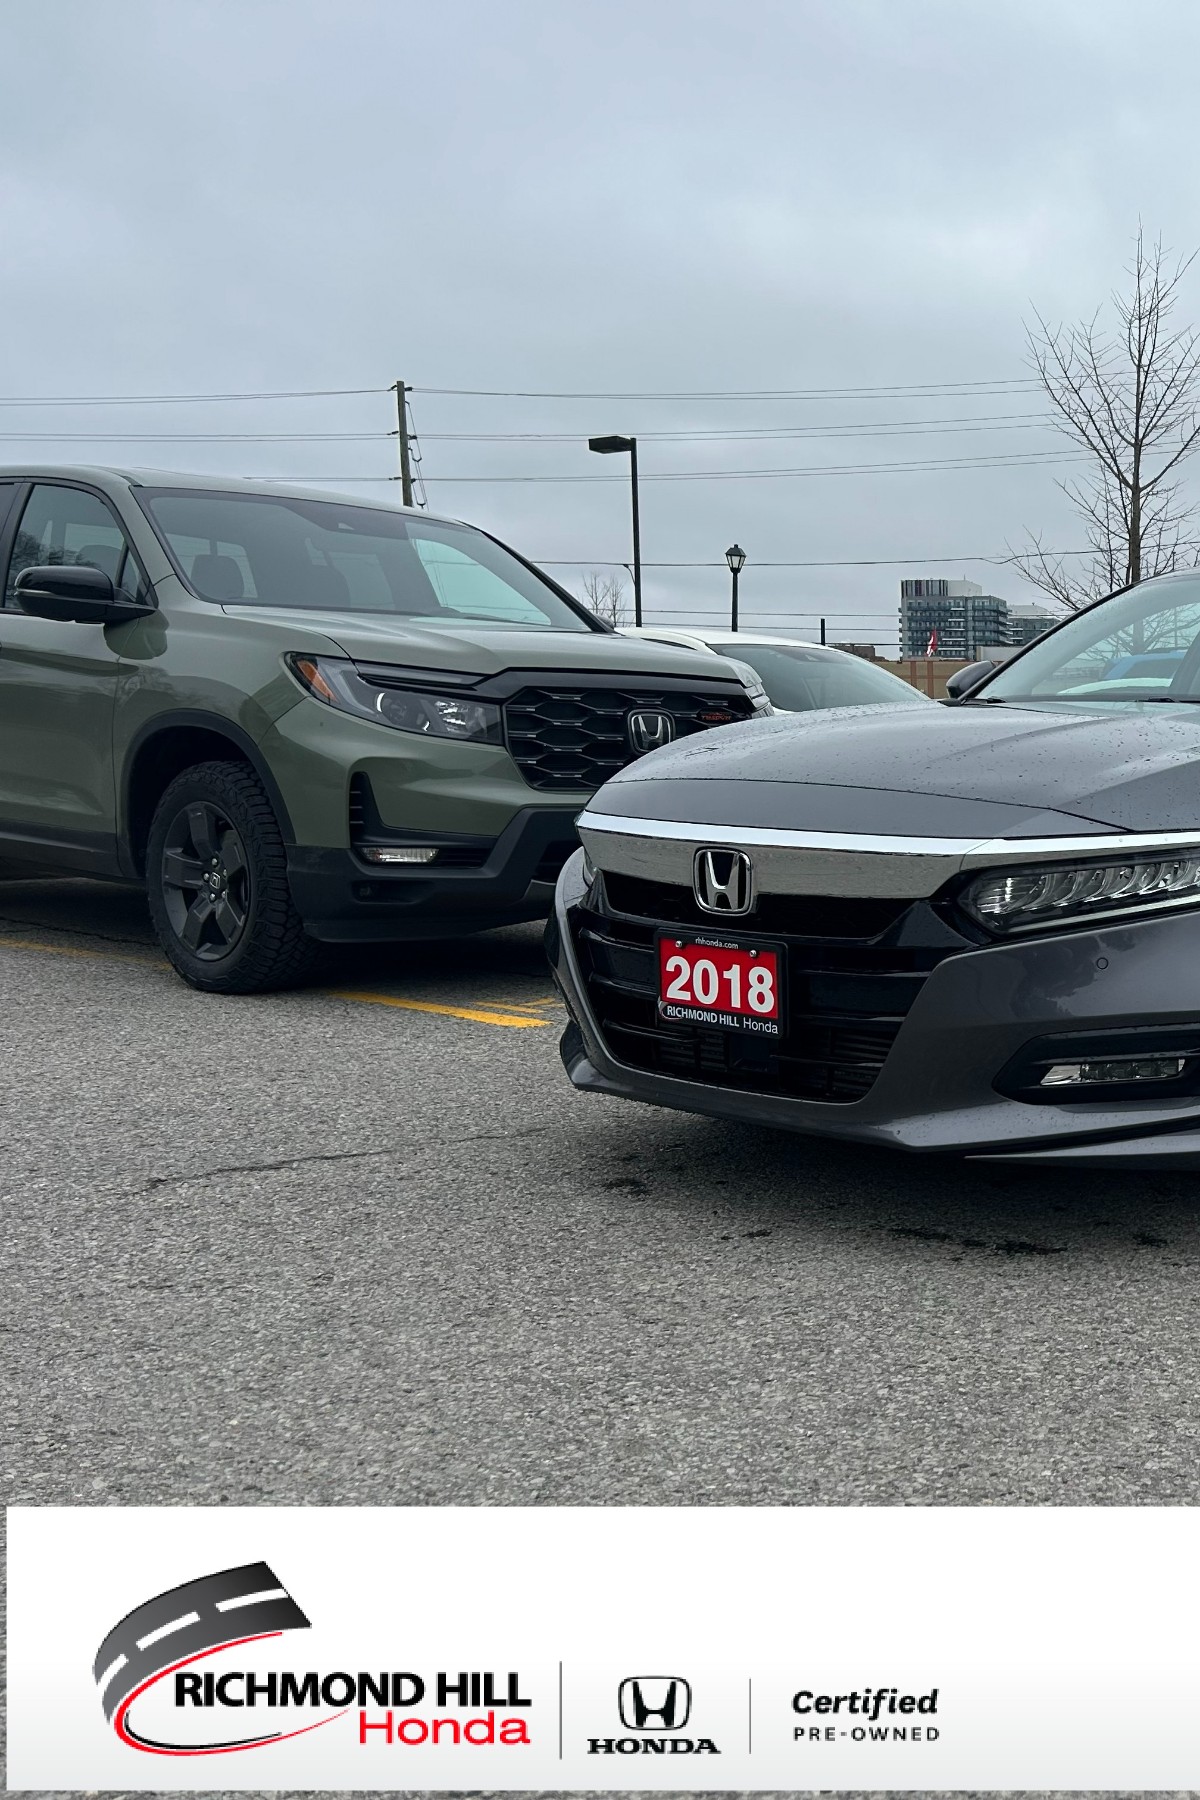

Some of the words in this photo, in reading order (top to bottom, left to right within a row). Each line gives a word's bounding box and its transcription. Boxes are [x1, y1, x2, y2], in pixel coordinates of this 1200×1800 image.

[665, 955, 775, 1013] 2018
[666, 1005, 718, 1023] RICHMOND
[719, 1014, 740, 1027] HILL
[743, 1017, 779, 1034] Honda
